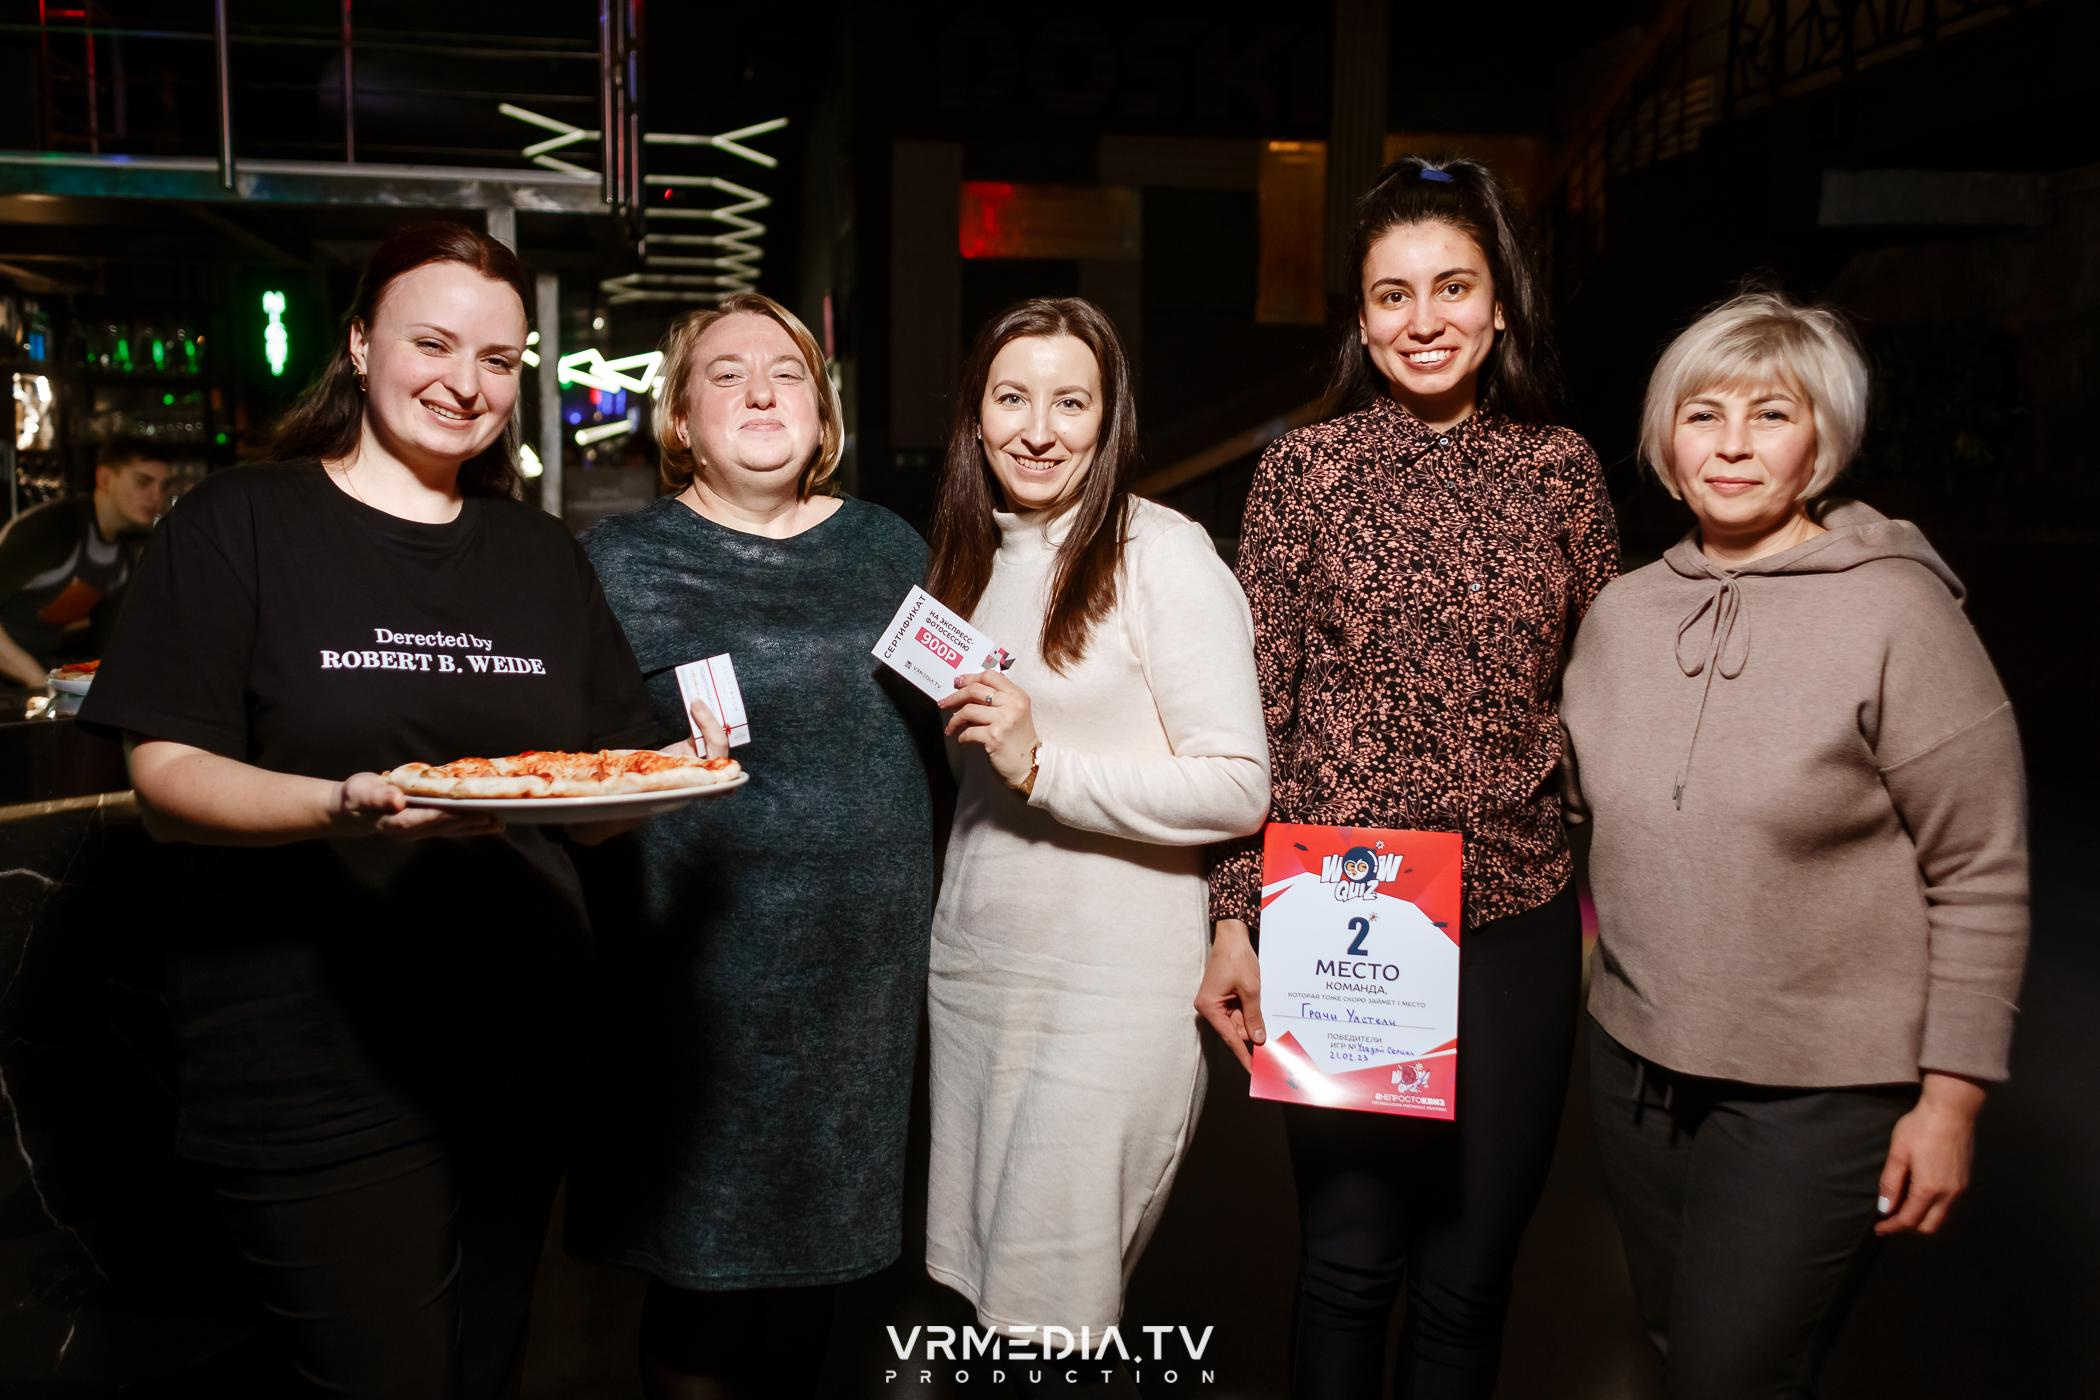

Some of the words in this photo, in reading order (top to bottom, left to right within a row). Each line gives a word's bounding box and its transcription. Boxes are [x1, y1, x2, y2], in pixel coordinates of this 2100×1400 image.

[884, 595, 926, 659] СЕРТИФИКАТ
[925, 617, 970, 652] ФОТОСЕССИЮ
[929, 610, 939, 620] НА
[939, 618, 974, 645] ЭКСПРЕСС-
[374, 628, 469, 647] Derected
[469, 634, 492, 651] by
[320, 650, 432, 671] ROBERT
[437, 655, 463, 673] B.
[466, 655, 546, 675] WEIDE
[1334, 879, 1379, 902] QUIZ
[1347, 916, 1370, 957] 2
[1315, 959, 1400, 981] МЕСТО
[1287, 991, 1320, 1000] КОТОРАЯ
[1342, 995, 1367, 1004] СКОРО
[1301, 1002, 1338, 1021] Грачи
[1327, 1032, 1382, 1043] ПОБЕДИТЕЛИ
